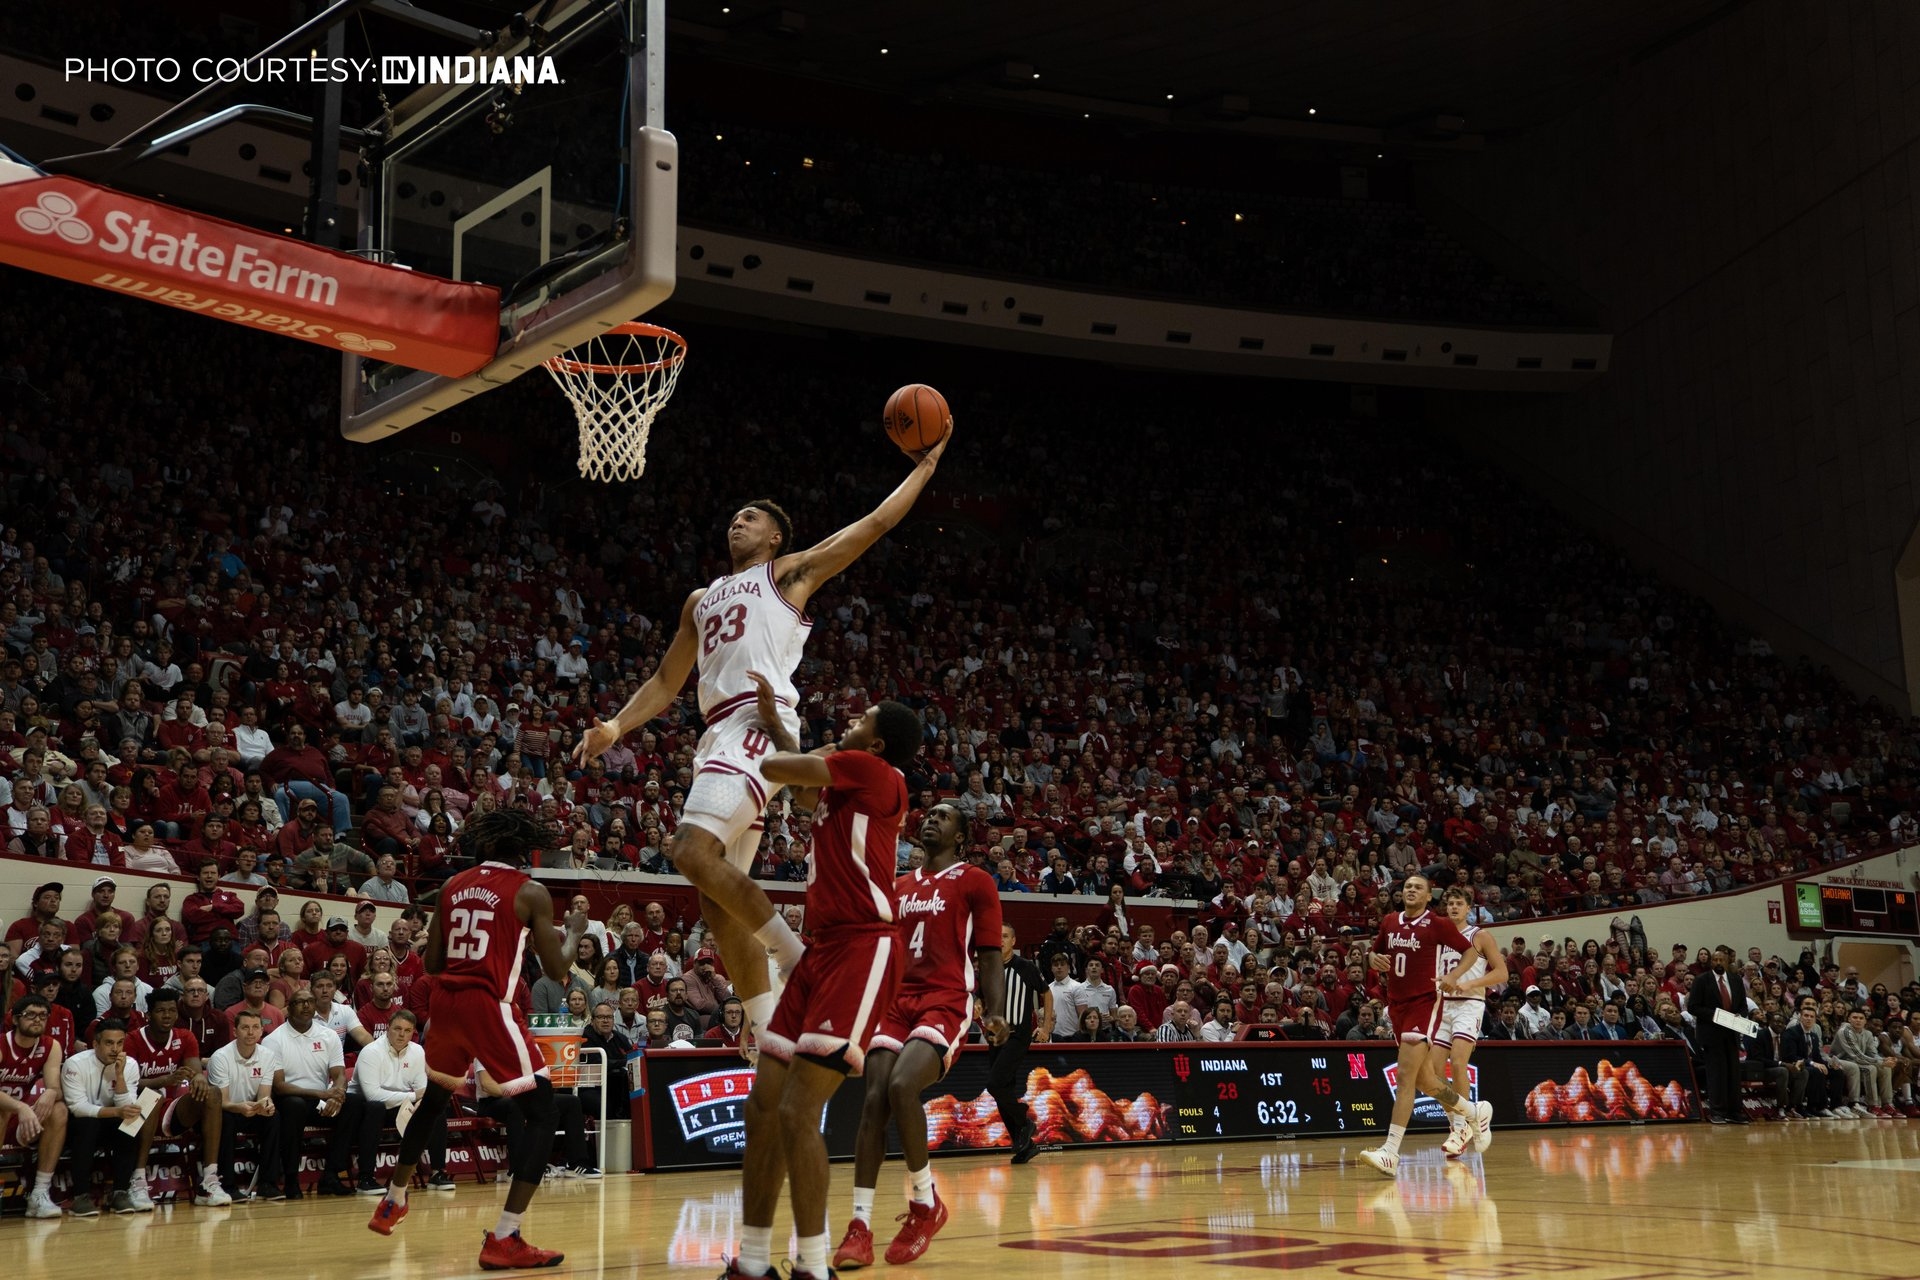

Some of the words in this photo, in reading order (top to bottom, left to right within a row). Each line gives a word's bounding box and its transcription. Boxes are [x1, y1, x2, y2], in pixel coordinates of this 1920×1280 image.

[451, 432, 461, 443] D
[703, 603, 748, 657] 23
[1822, 887, 1851, 899] INDIANA
[899, 889, 946, 920] Nebraska
[447, 907, 495, 960] 25
[909, 921, 925, 958] 4
[1388, 932, 1420, 952] Nebraska
[1395, 953, 1406, 977] 0
[563, 1041, 576, 1061] G
[1200, 1059, 1248, 1072] INDIANA
[1311, 1057, 1327, 1069] NU
[253, 1067, 262, 1076] N
[1260, 1073, 1282, 1086] 1ST
[682, 1077, 753, 1104] INDI
[1217, 1082, 1239, 1100] 28
[1312, 1078, 1331, 1096] 15
[1179, 1107, 1204, 1117] FOULS
[1213, 1106, 1220, 1118] 4
[1257, 1100, 1299, 1124] 6:32
[1335, 1101, 1342, 1112] 2
[1352, 1102, 1374, 1112] FOULS
[1338, 1118, 1345, 1130] 3
[1362, 1117, 1377, 1127] TOL
[1181, 1124, 1197, 1134] TOL
[1216, 1123, 1222, 1135] 4
[713, 1131, 746, 1146] PREM
